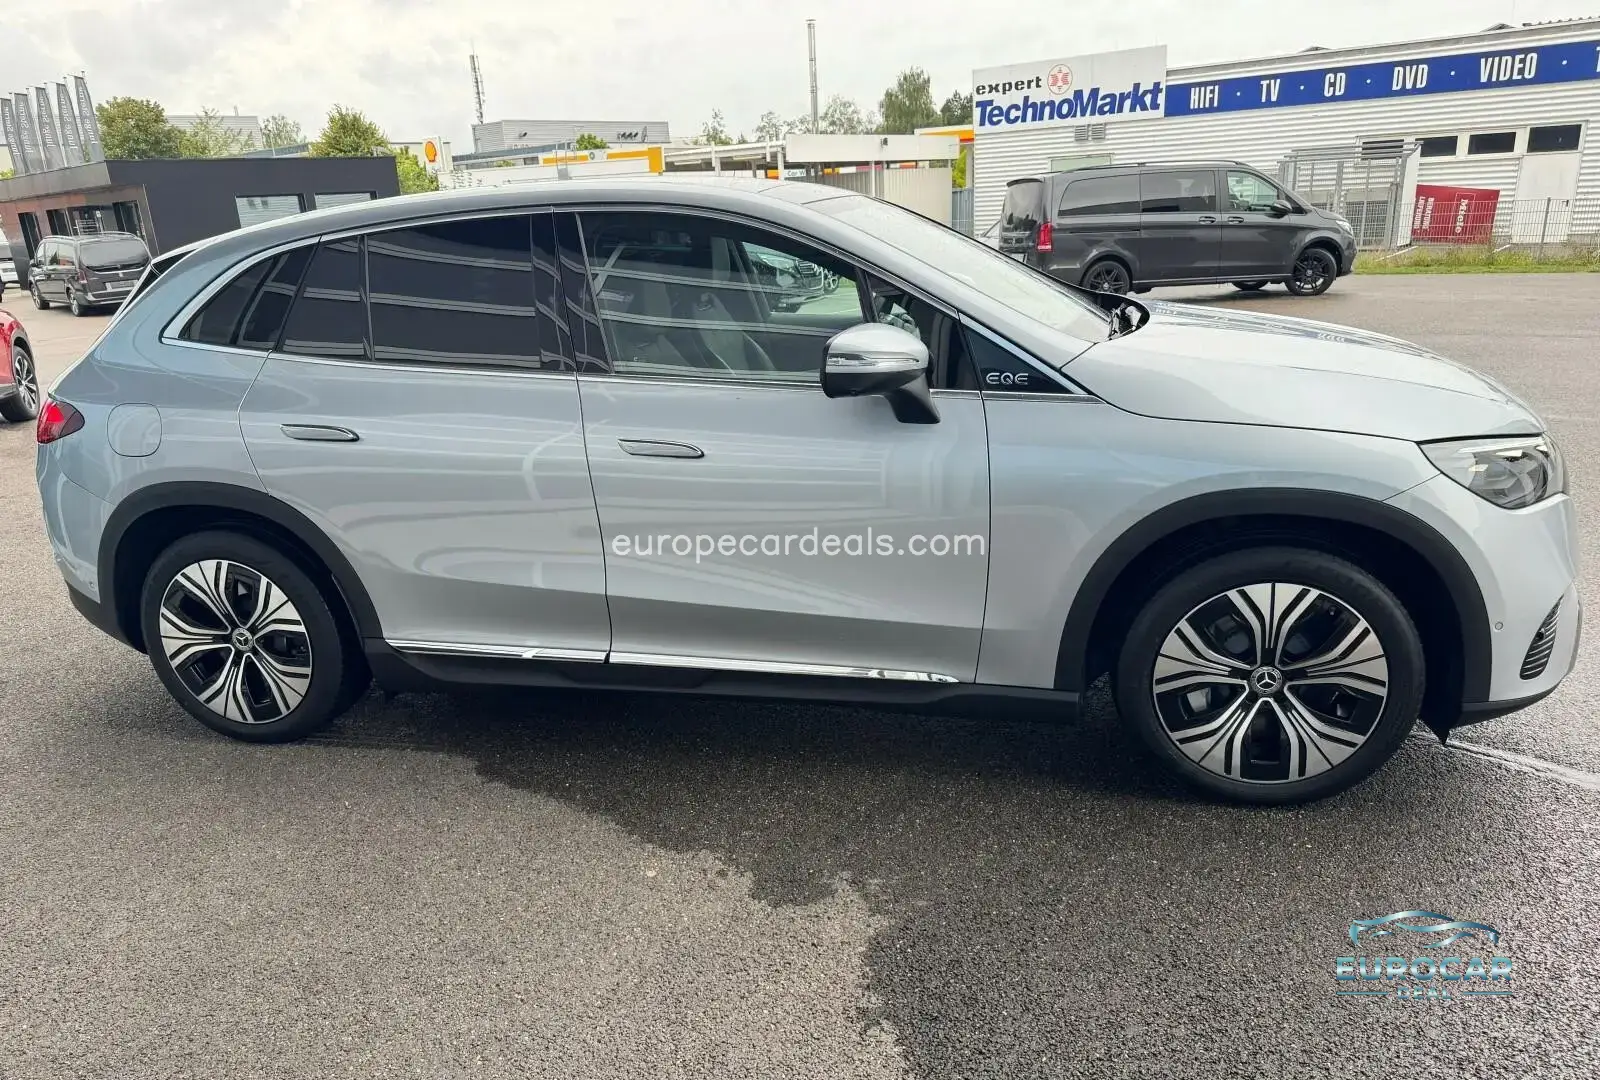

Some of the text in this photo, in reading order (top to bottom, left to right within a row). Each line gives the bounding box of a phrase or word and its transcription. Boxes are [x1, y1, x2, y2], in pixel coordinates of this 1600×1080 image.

[975, 76, 1042, 95] expert
[1189, 52, 1538, 109] HIFI TV CD DVD VIDEO
[975, 82, 1164, 127] TechnoMarkt
[986, 372, 1029, 385] EQE
